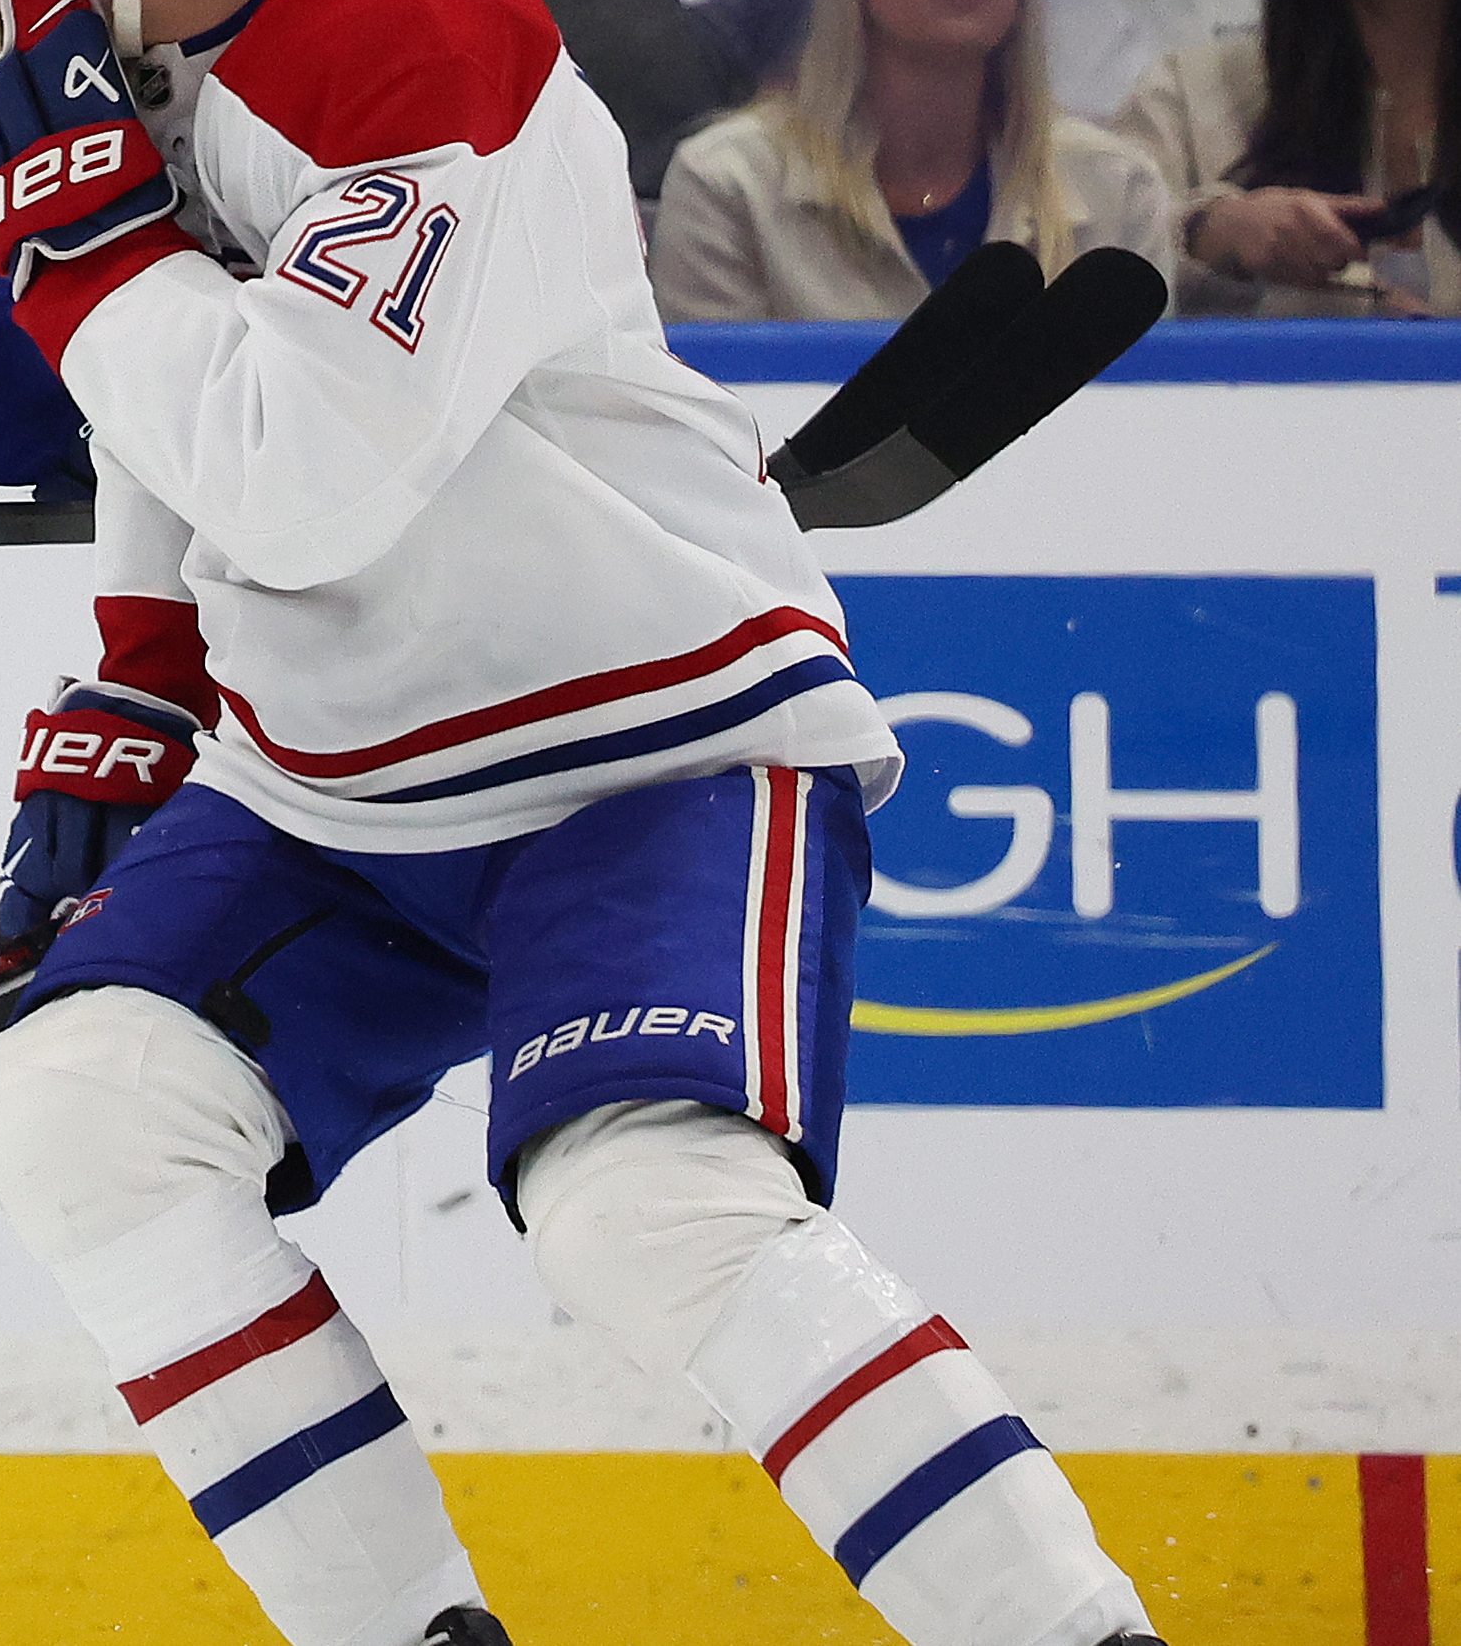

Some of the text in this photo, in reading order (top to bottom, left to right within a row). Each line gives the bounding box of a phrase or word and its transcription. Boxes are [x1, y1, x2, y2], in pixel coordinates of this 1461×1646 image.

[276, 170, 460, 355] 21
[16, 721, 167, 785] UER
[871, 691, 1301, 920] GH
[508, 1004, 737, 1082] BAUER
